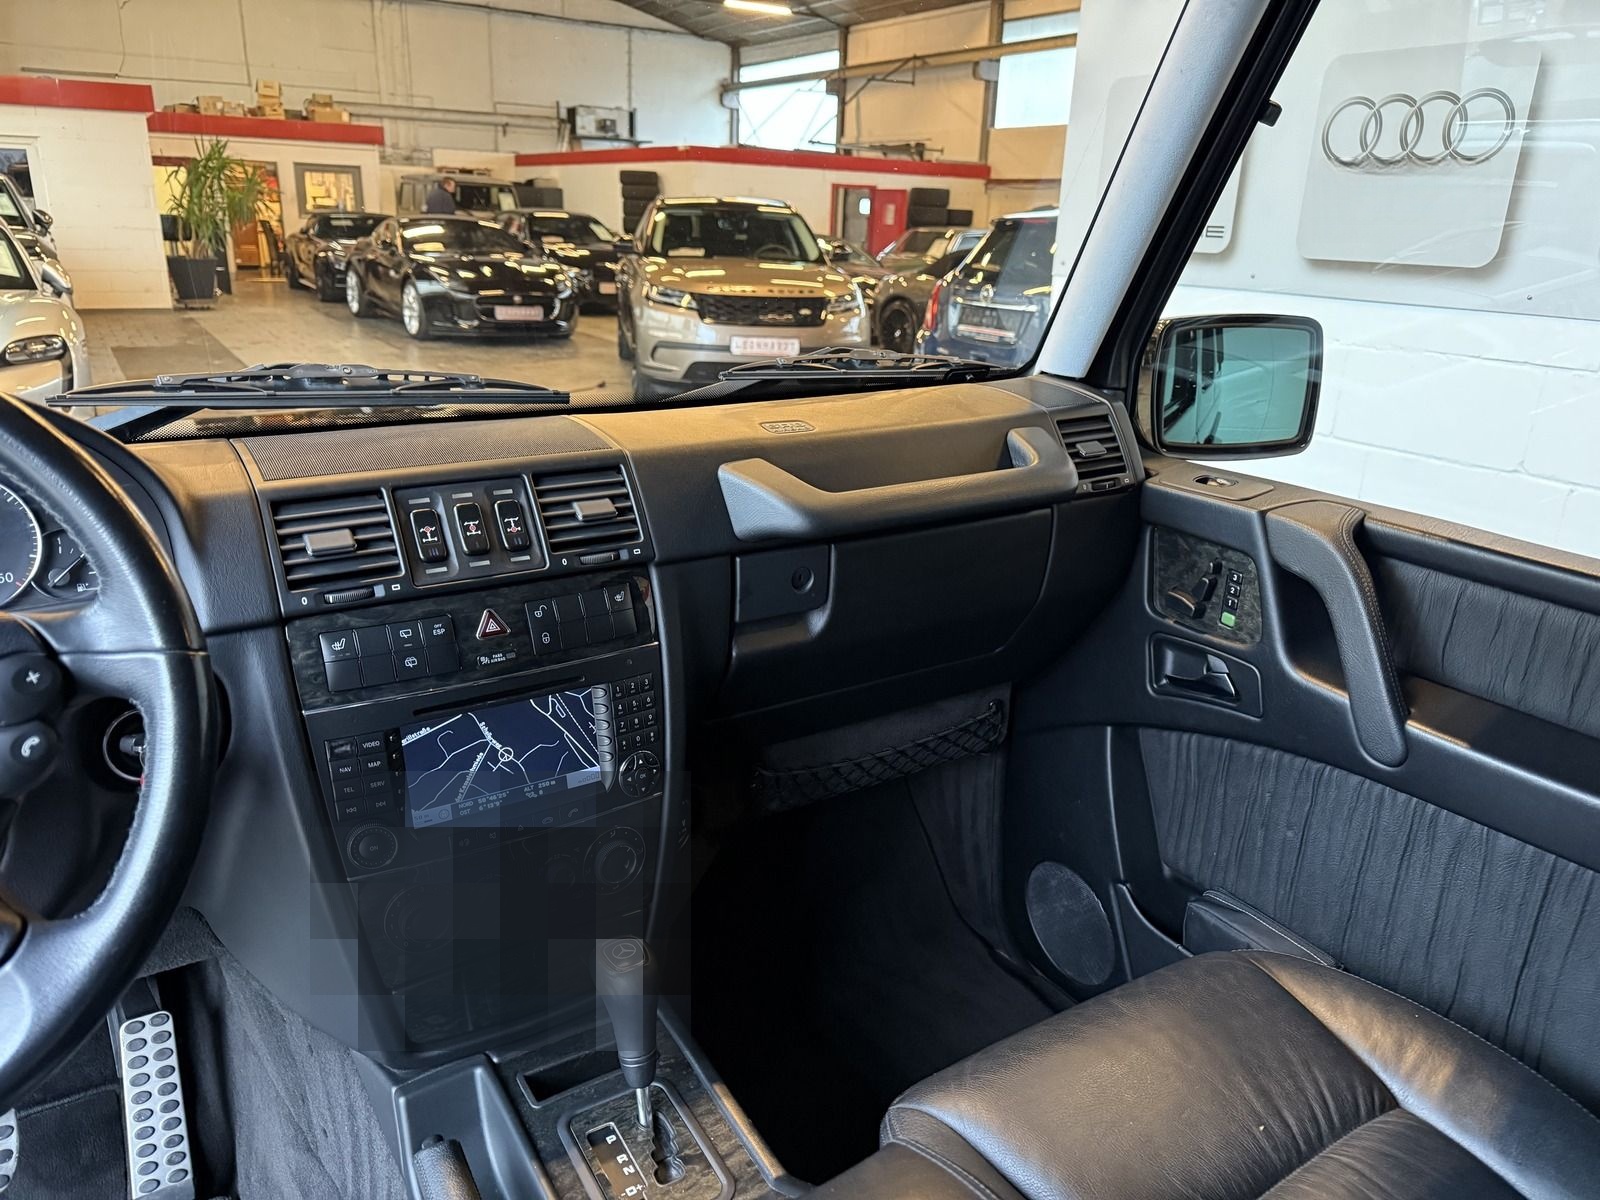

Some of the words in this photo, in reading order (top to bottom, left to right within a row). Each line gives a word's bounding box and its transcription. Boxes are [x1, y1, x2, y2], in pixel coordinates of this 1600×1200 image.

[433, 628, 446, 636] ESP
[362, 740, 380, 749] VIDEO
[367, 760, 381, 768] MAP
[370, 780, 385, 788] SERV
[523, 784, 534, 792] ALT
[538, 781, 550, 789] 250
[458, 800, 474, 809] NORD
[459, 808, 471, 816] OST
[605, 1134, 617, 1145] P
[616, 1153, 629, 1164] R
[622, 1164, 635, 1176] N
